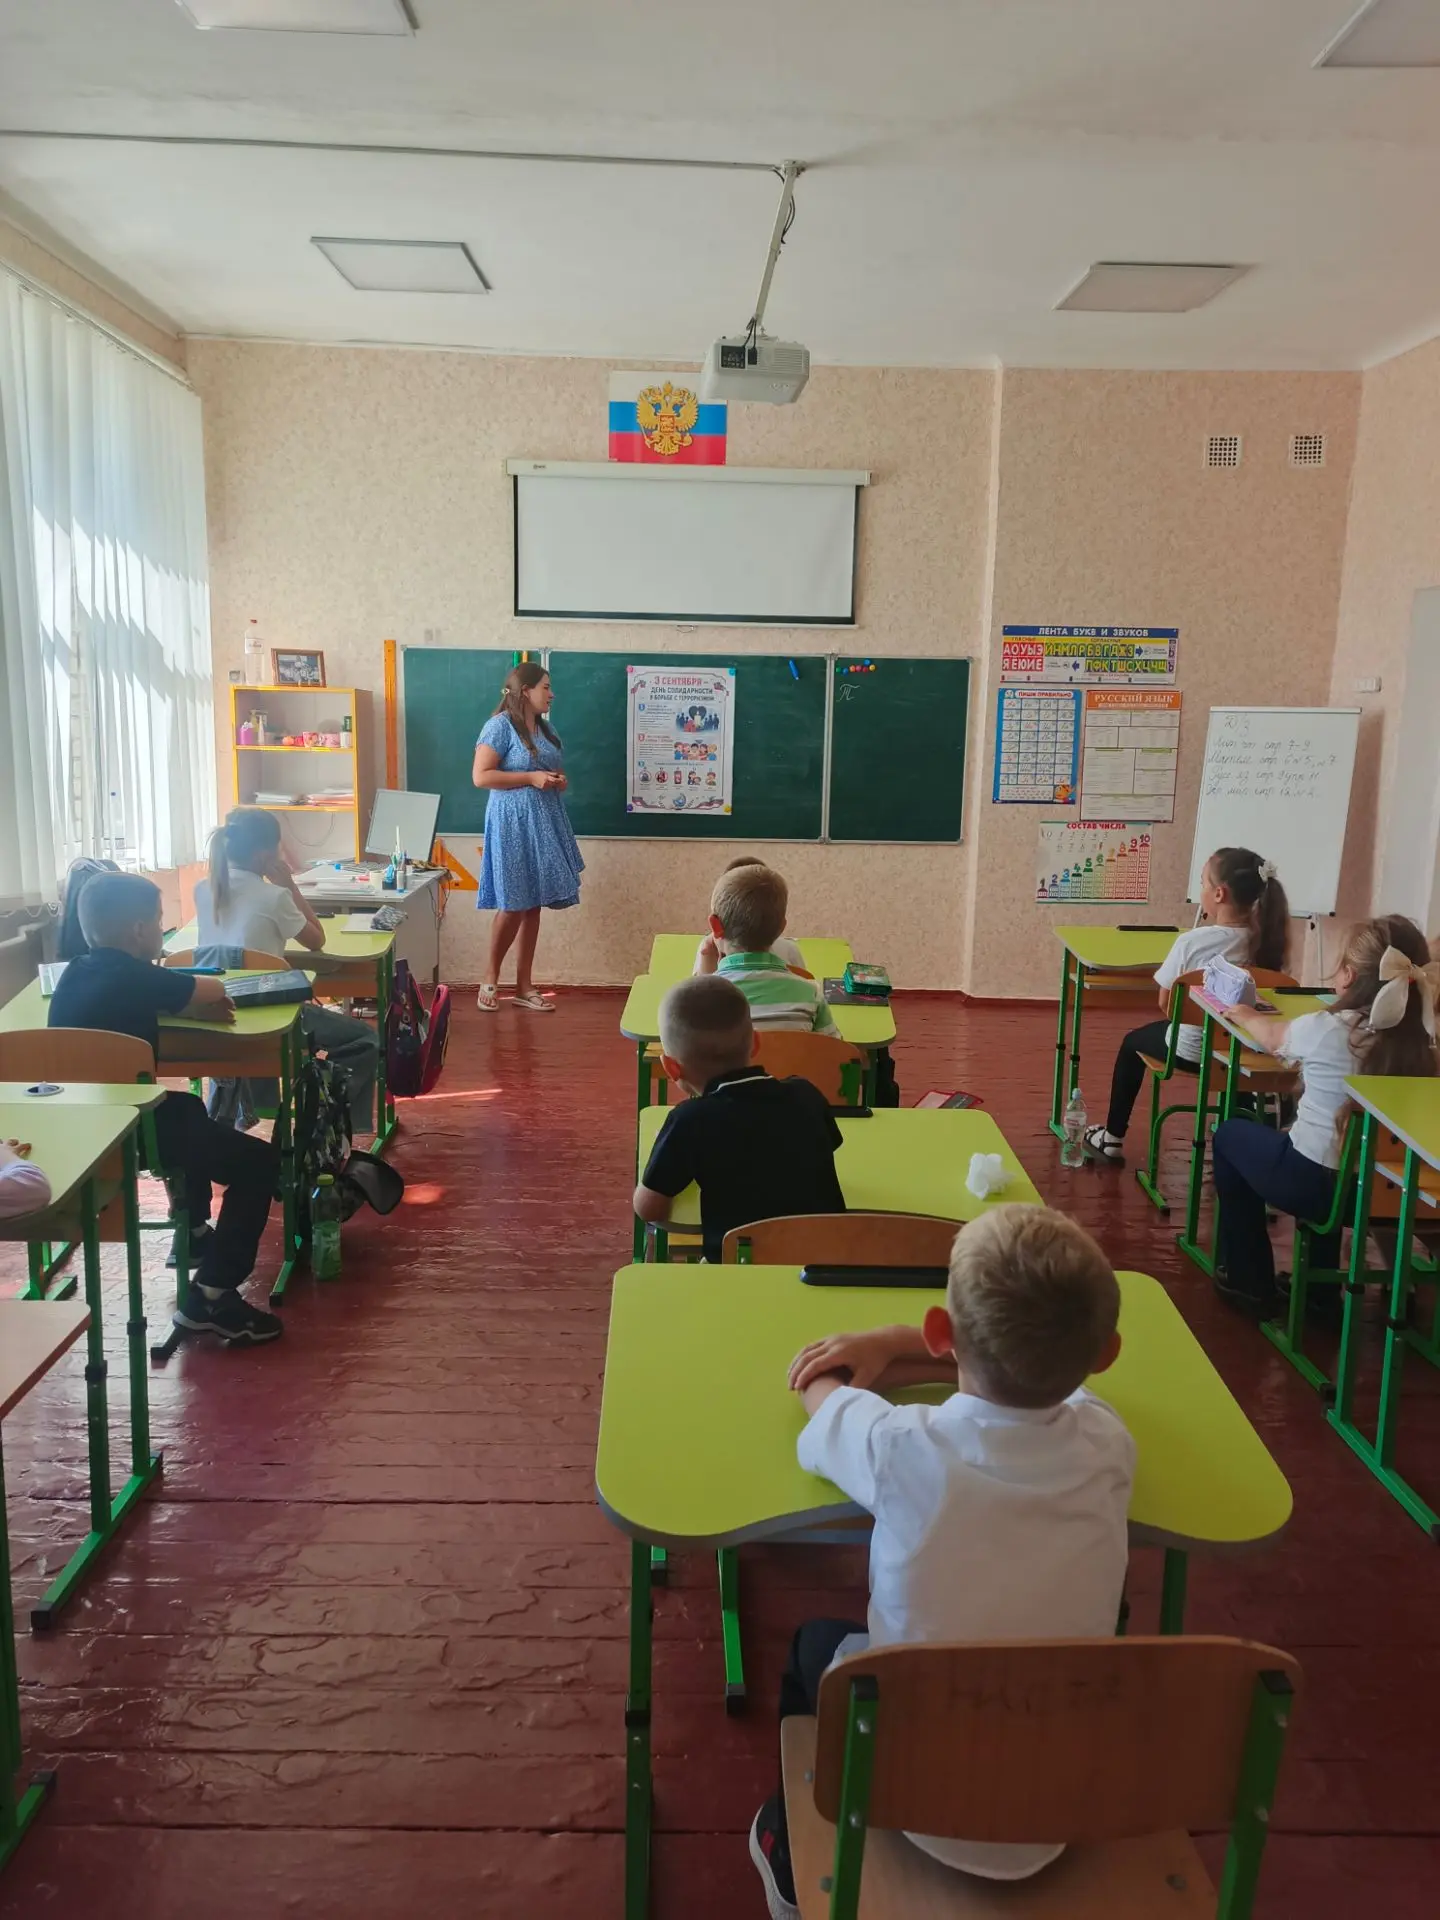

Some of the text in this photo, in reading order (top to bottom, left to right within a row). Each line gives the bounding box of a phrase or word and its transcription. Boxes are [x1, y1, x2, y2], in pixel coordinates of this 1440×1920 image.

[1038, 627, 1149, 636] ЛЕНТА БУКВ И ЗВУКОВ
[654, 676, 702, 685] 3 СЕНТЯБРЯ
[1094, 692, 1174, 703] РУССКИЙ ЯЗЫК
[1130, 838, 1138, 848] 9
[1140, 833, 1150, 843] 10
[1120, 841, 1126, 853] 8
[1085, 857, 1092, 867] 5
[1096, 853, 1104, 863] 6
[1074, 863, 1081, 872] 4
[1052, 873, 1058, 883] 2
[1063, 868, 1070, 878] 3
[1040, 878, 1045, 887] 1
